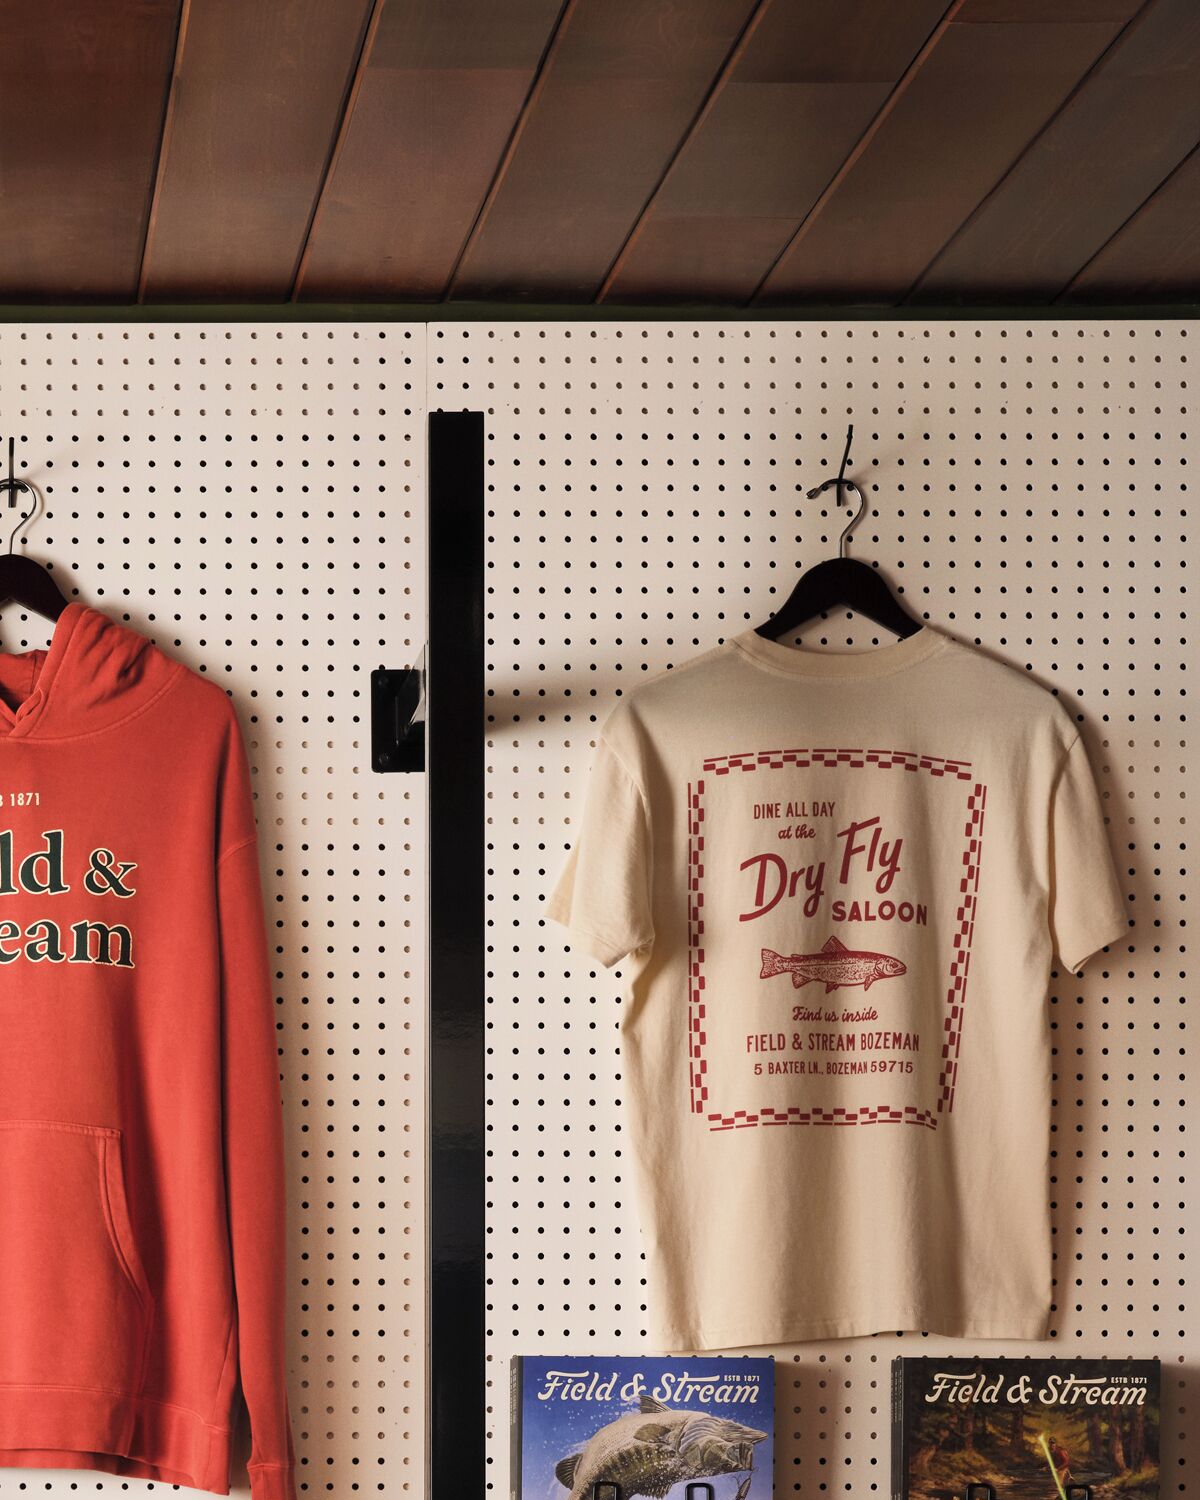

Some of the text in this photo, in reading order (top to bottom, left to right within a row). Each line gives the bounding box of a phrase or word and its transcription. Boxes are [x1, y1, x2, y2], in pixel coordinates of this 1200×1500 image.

[9, 792, 40, 807] 1871
[753, 801, 835, 820] DINE ALL DAY
[778, 824, 816, 840] at the
[83, 847, 137, 898] &
[739, 816, 903, 922] Dry Fly
[832, 900, 928, 926] SALOON
[792, 1006, 878, 1023] Find us inside
[746, 1032, 920, 1052] FIELD & STREAM BOZEMAN
[754, 1062, 763, 1075] 5
[768, 1061, 806, 1075] BAXTER
[826, 1060, 868, 1075] BOZEMAN
[870, 1060, 913, 1074] 59715
[537, 1370, 619, 1401] Field
[620, 1371, 647, 1401] &
[653, 1371, 760, 1403] Stream
[723, 1374, 740, 1382] ESTB
[743, 1374, 760, 1382] 1871
[925, 1372, 1004, 1403] Field
[1006, 1375, 1033, 1404] &
[1038, 1373, 1148, 1405] Stream
[1110, 1376, 1128, 1384] ESTB
[1130, 1376, 1148, 1384] 1871
